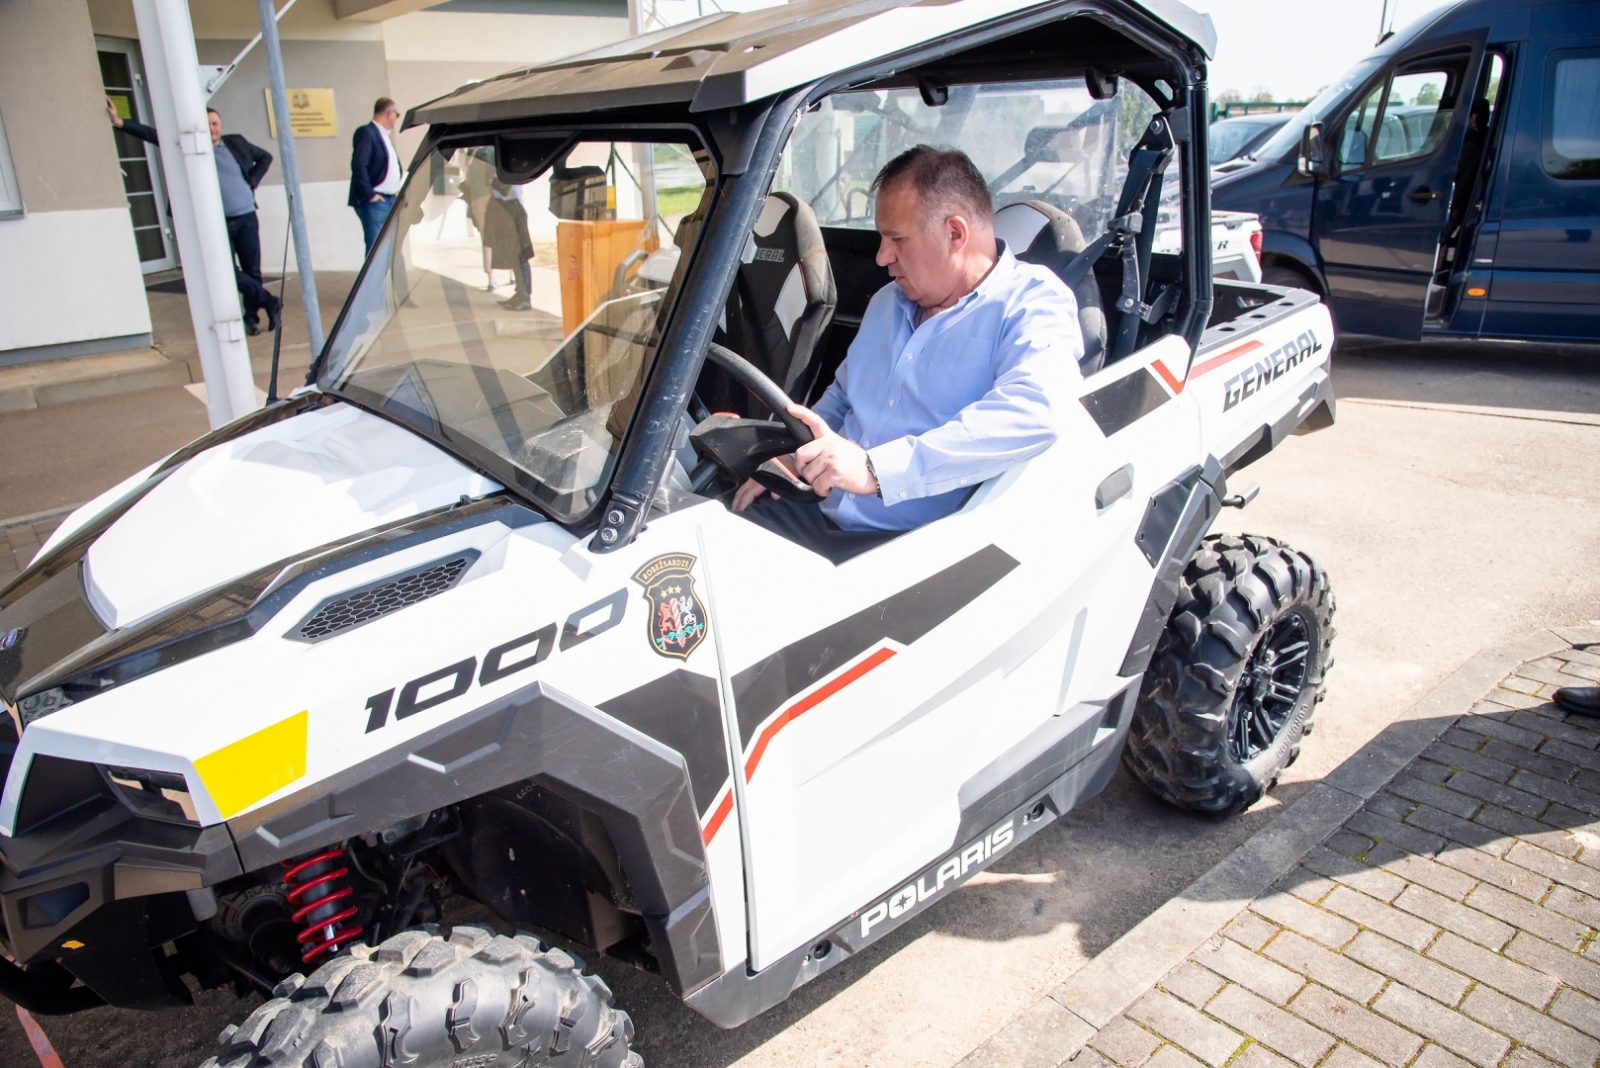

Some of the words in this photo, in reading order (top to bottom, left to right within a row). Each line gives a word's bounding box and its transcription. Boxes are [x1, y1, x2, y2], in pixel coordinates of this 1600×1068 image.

[1223, 329, 1322, 413] GENERAL
[642, 559, 690, 580] ROBEŽSARDZE
[365, 587, 628, 734] 1000
[861, 819, 1014, 938] POLARIS
